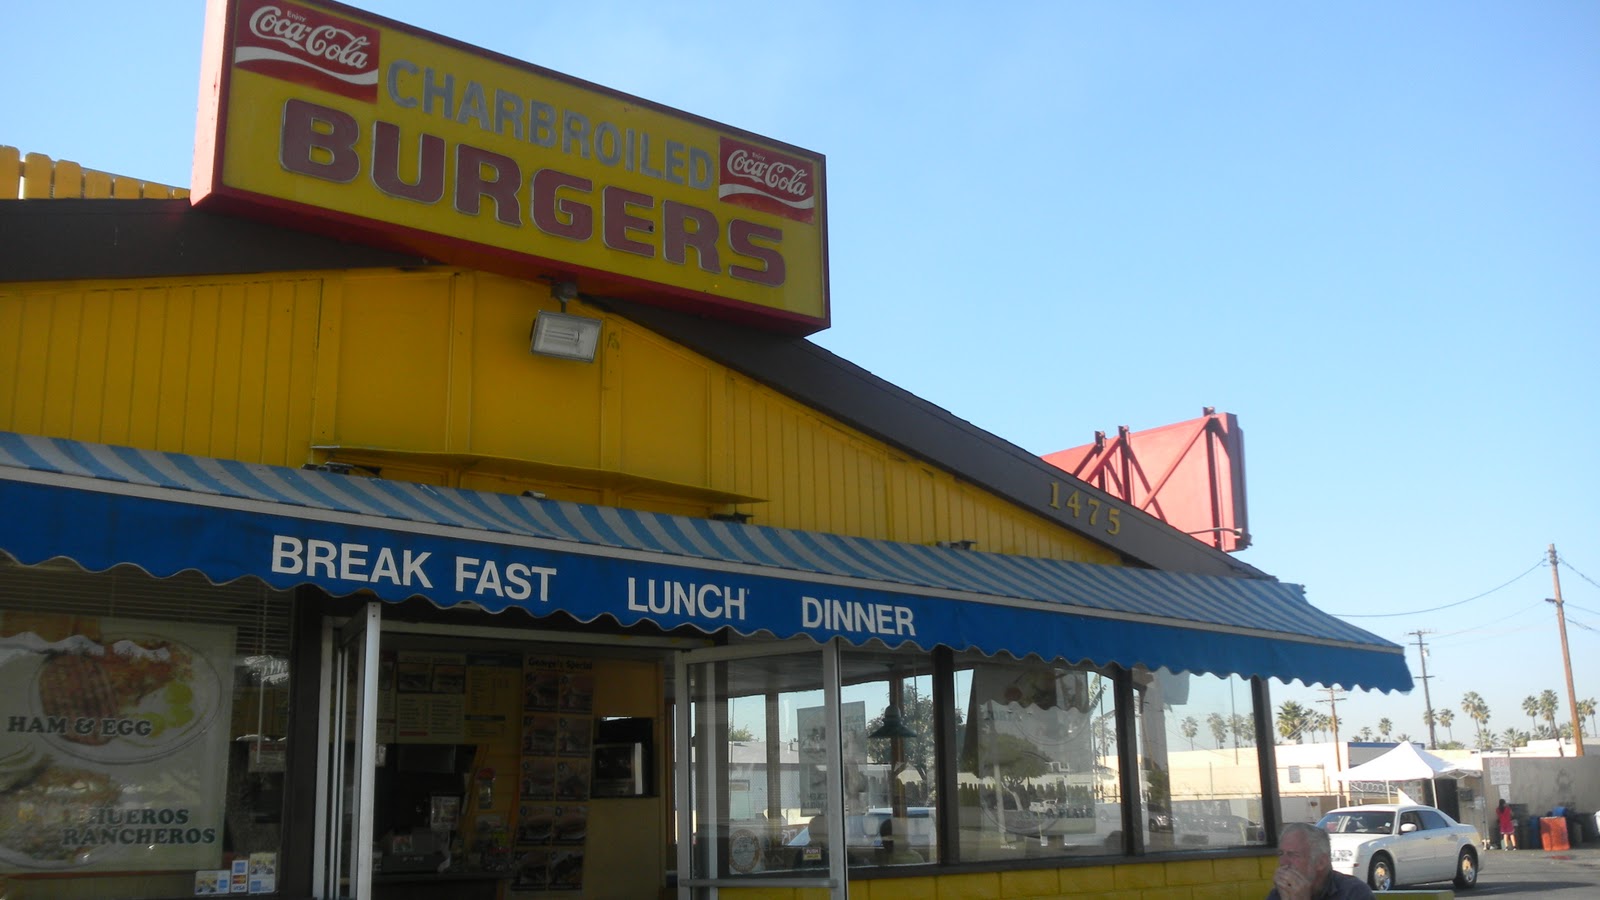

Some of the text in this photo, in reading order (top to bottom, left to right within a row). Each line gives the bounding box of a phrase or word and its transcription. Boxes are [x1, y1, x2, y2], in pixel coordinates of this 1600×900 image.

[287, 10, 307, 23] Enjoy
[386, 58, 714, 191] CHARBROILED
[279, 98, 786, 288] BURGERS
[1049, 481, 1121, 535] 1475
[271, 534, 916, 636] BREAK FAST LUNCH DINNER
[7, 716, 153, 737] HAM & EGG
[61, 828, 216, 846] RANCHEROS
